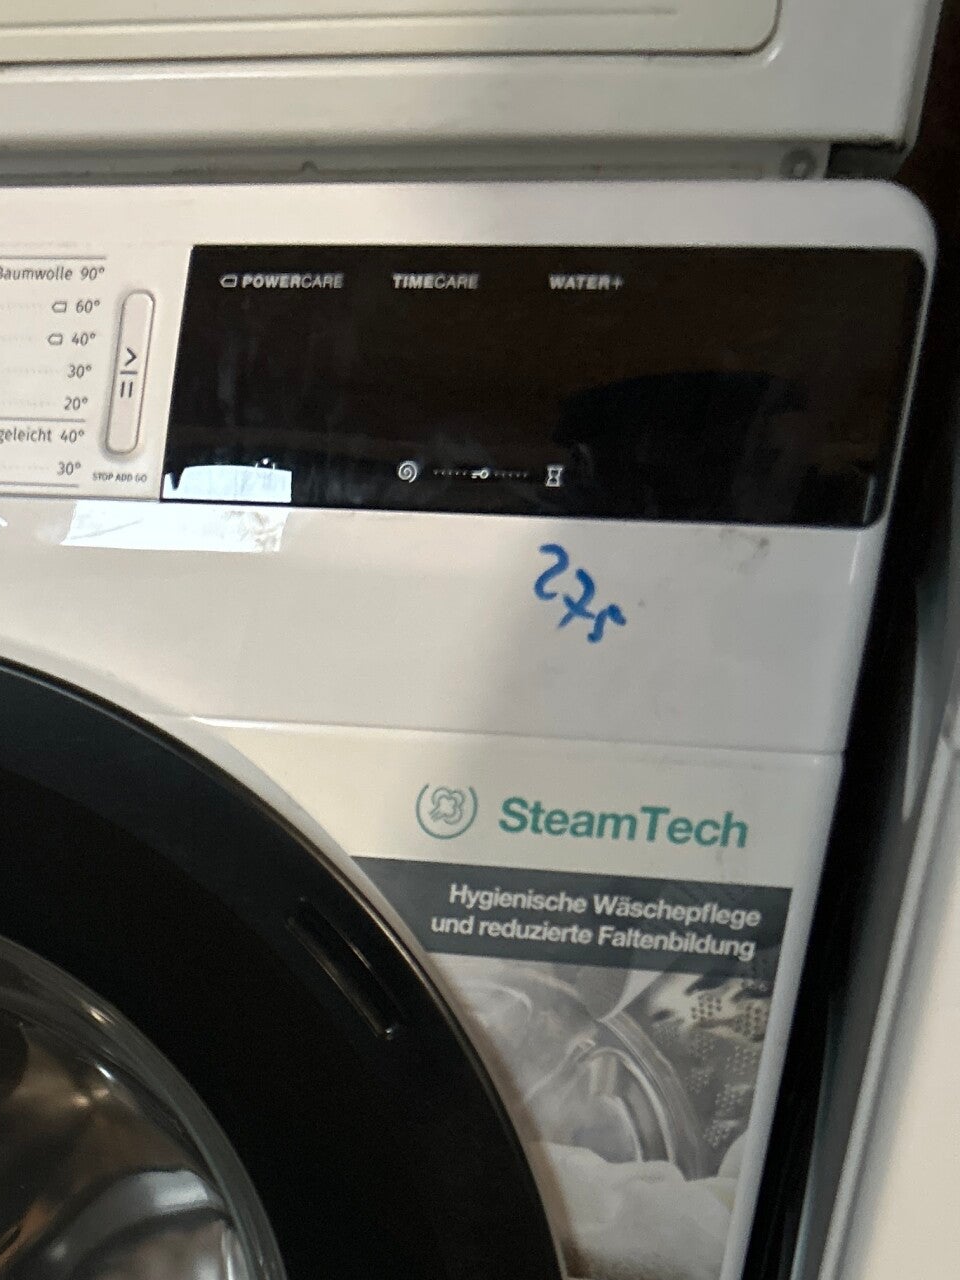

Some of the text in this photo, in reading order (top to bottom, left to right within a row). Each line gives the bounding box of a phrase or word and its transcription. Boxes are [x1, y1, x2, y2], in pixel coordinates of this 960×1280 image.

[81, 267, 105, 281] 90°
[241, 273, 344, 289] POWERCARE
[392, 273, 479, 289] TIMECARE
[549, 274, 624, 290] WATER+
[76, 300, 100, 314] 60°
[72, 333, 96, 346] 40°
[67, 364, 92, 378] 30°
[64, 397, 88, 411] 20°
[60, 430, 84, 443] 40°
[57, 462, 82, 476] 30°
[93, 472, 113, 482] STOP
[115, 473, 132, 482] ADD
[498, 797, 749, 849] SteamTech
[449, 882, 762, 928] Hygienische Wäschepflege
[431, 914, 756, 962] und reduzierte Faltenbildung
